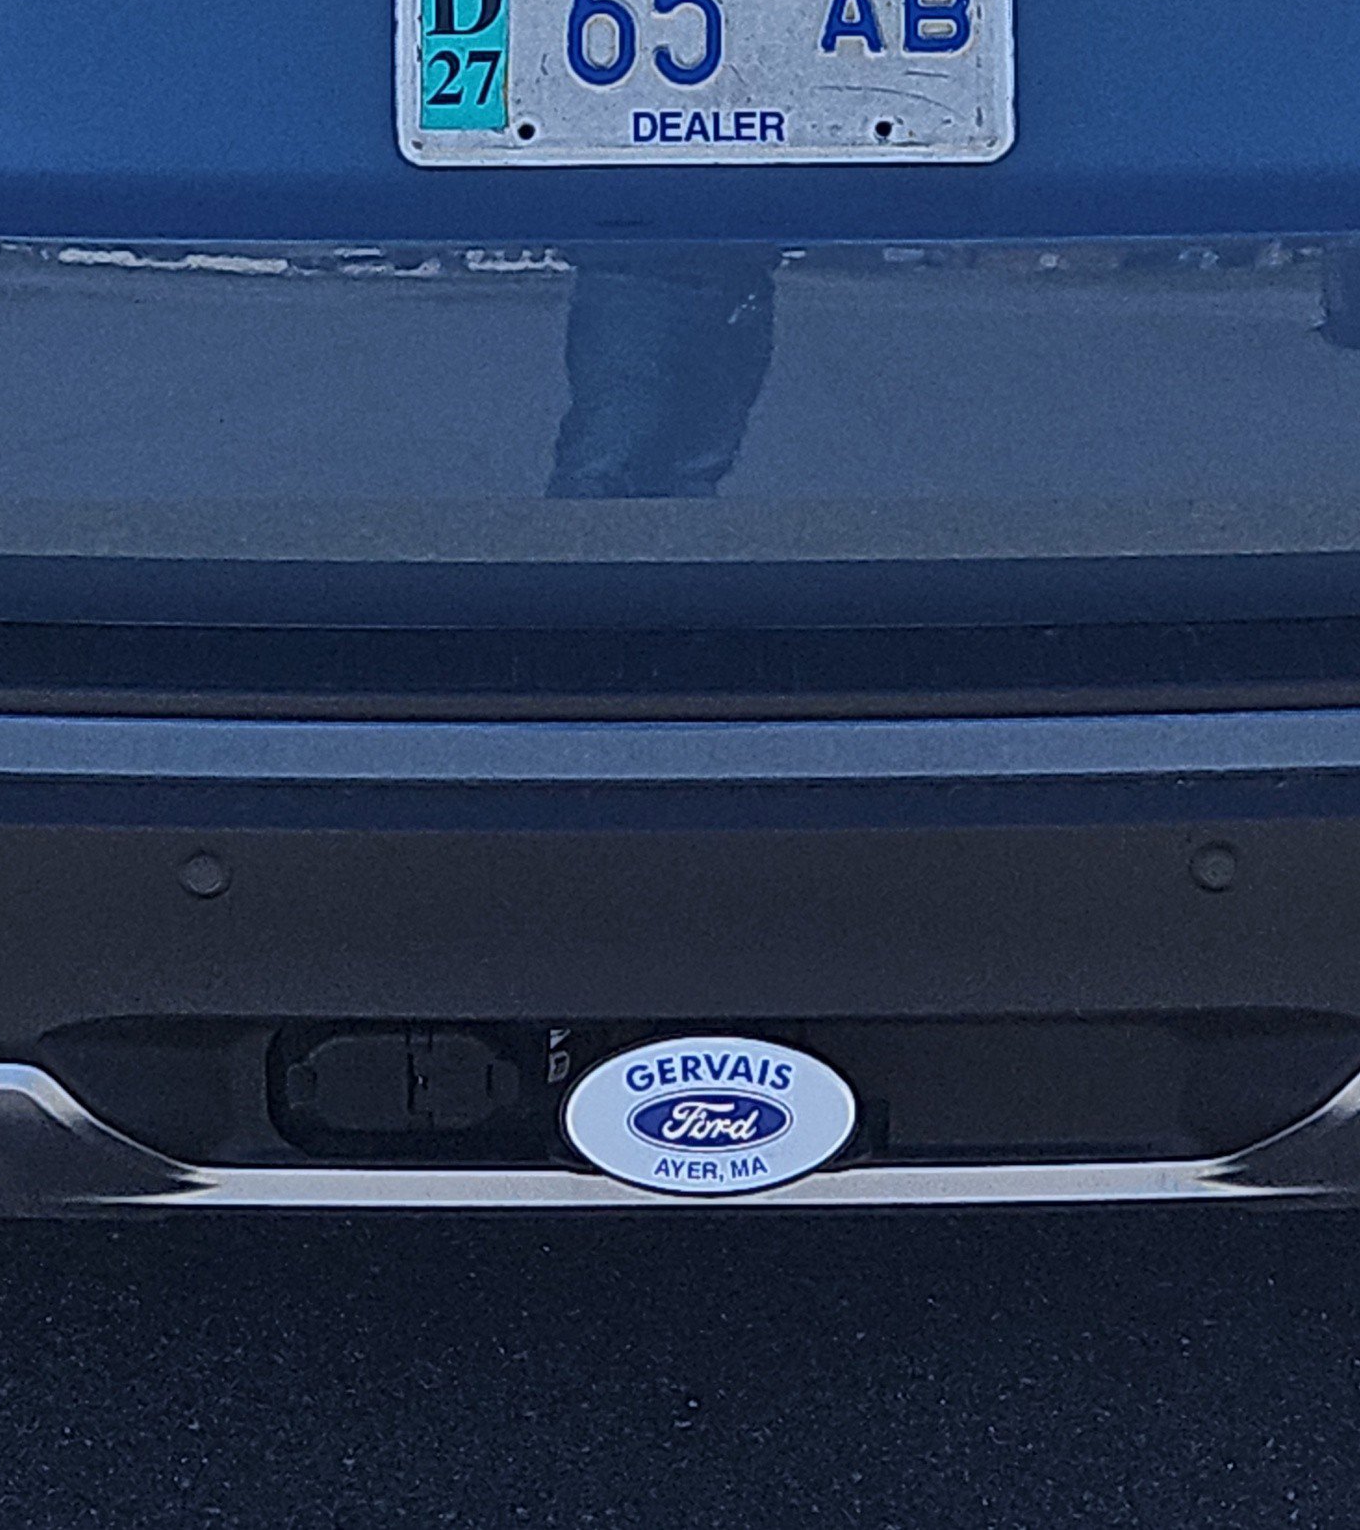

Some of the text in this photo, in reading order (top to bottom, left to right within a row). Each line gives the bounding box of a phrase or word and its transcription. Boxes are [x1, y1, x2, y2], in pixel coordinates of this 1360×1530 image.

[425, 51, 504, 107] 27
[632, 111, 787, 143] DEALER
[625, 1053, 794, 1092] GERVAIS
[661, 1100, 761, 1141] Ford
[654, 1155, 768, 1182] AYER, MA
